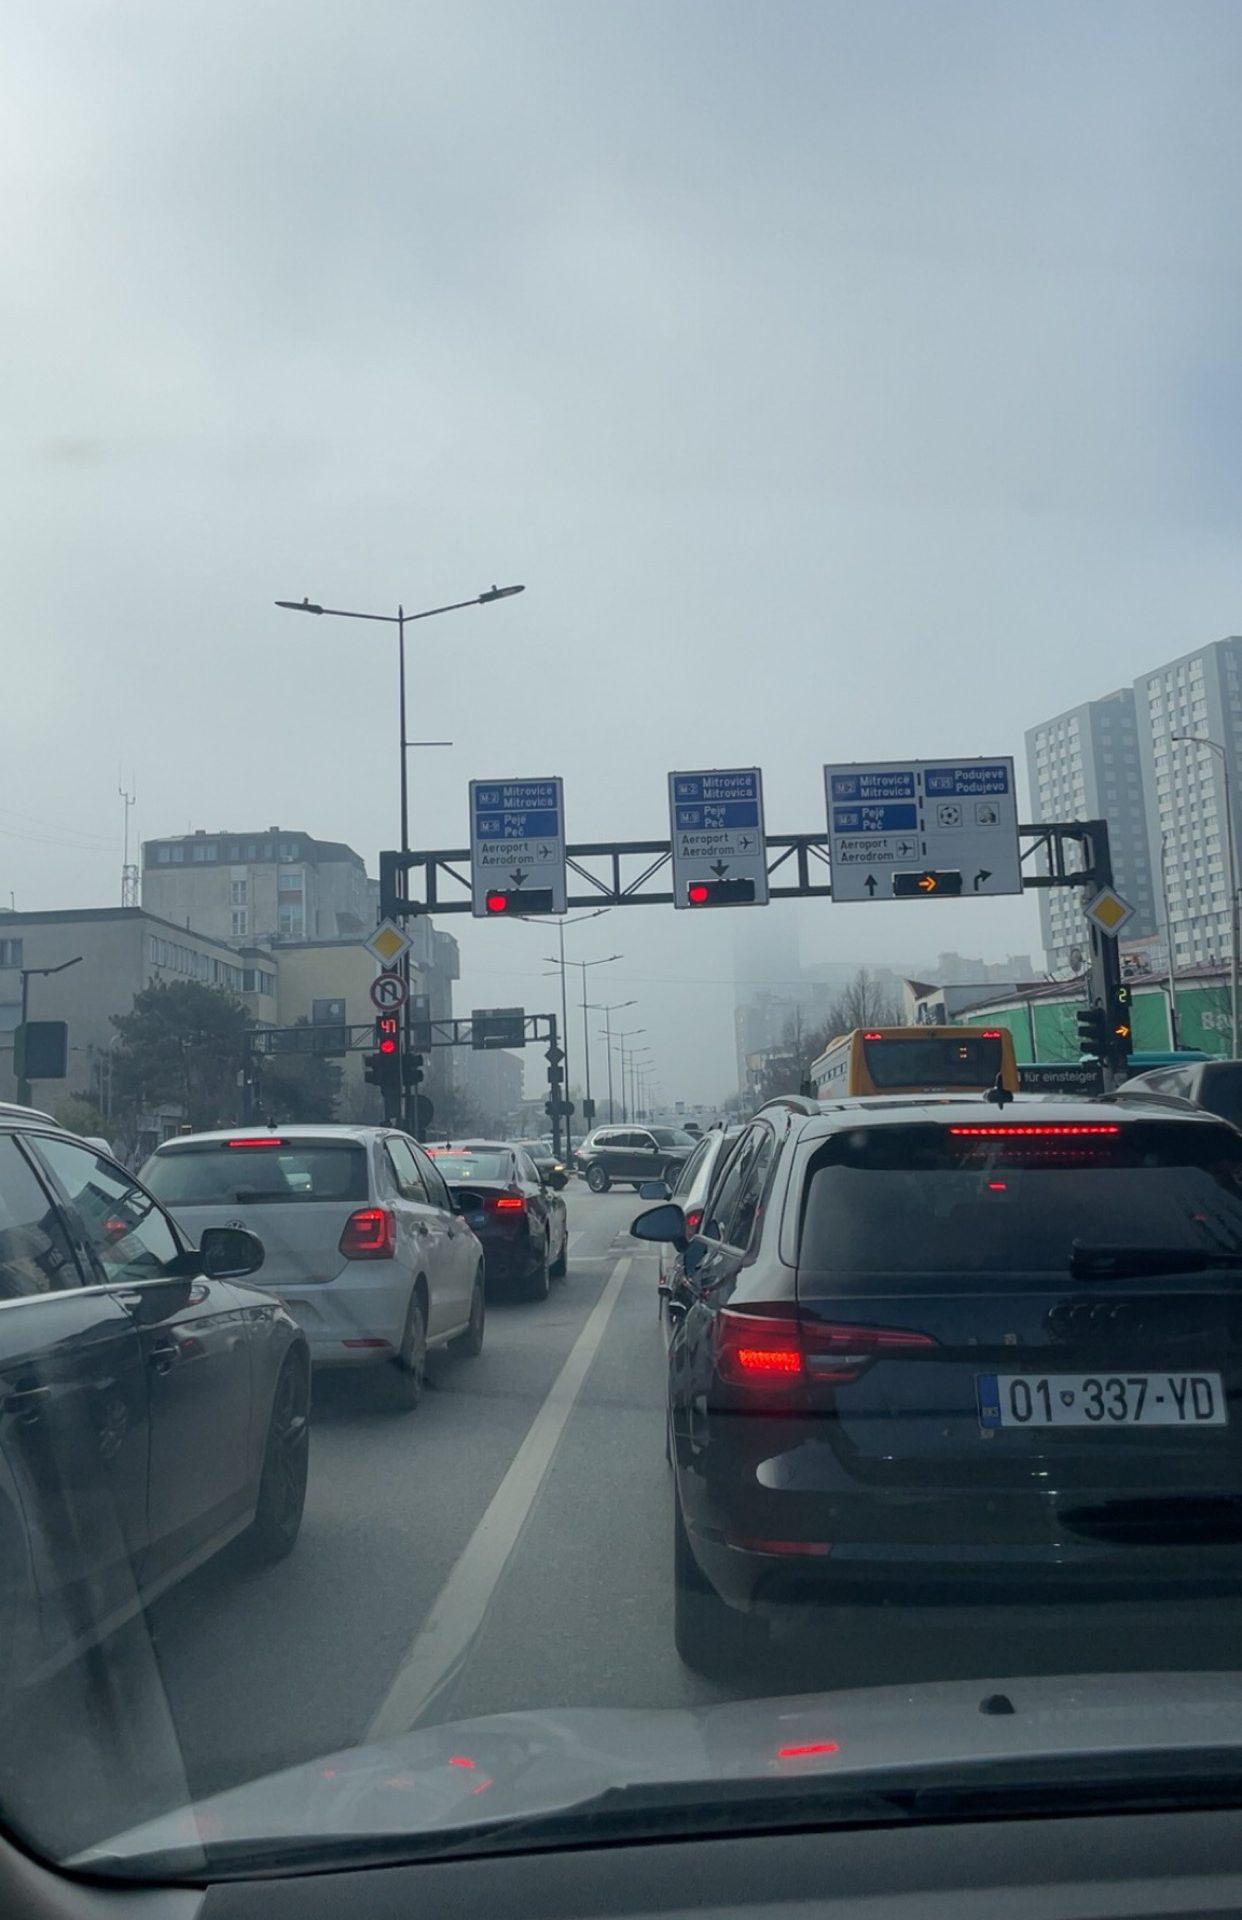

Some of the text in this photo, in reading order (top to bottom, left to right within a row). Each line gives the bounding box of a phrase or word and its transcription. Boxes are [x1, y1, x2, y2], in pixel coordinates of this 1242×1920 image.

[956, 781, 1005, 793] Podujevo
[703, 788, 753, 798] Mitrovica
[861, 787, 911, 798] Mitrovica
[503, 797, 554, 808] Mitrovica
[682, 833, 729, 845] Aeroport
[482, 842, 529, 854] Aeroport
[841, 840, 887, 850] Aeroport
[683, 846, 735, 856] Aerodrom
[482, 855, 535, 864] Aerodrom
[842, 852, 894, 862] Aerodrom
[1119, 988, 1127, 1002] 2
[1024, 1071, 1039, 1081] für
